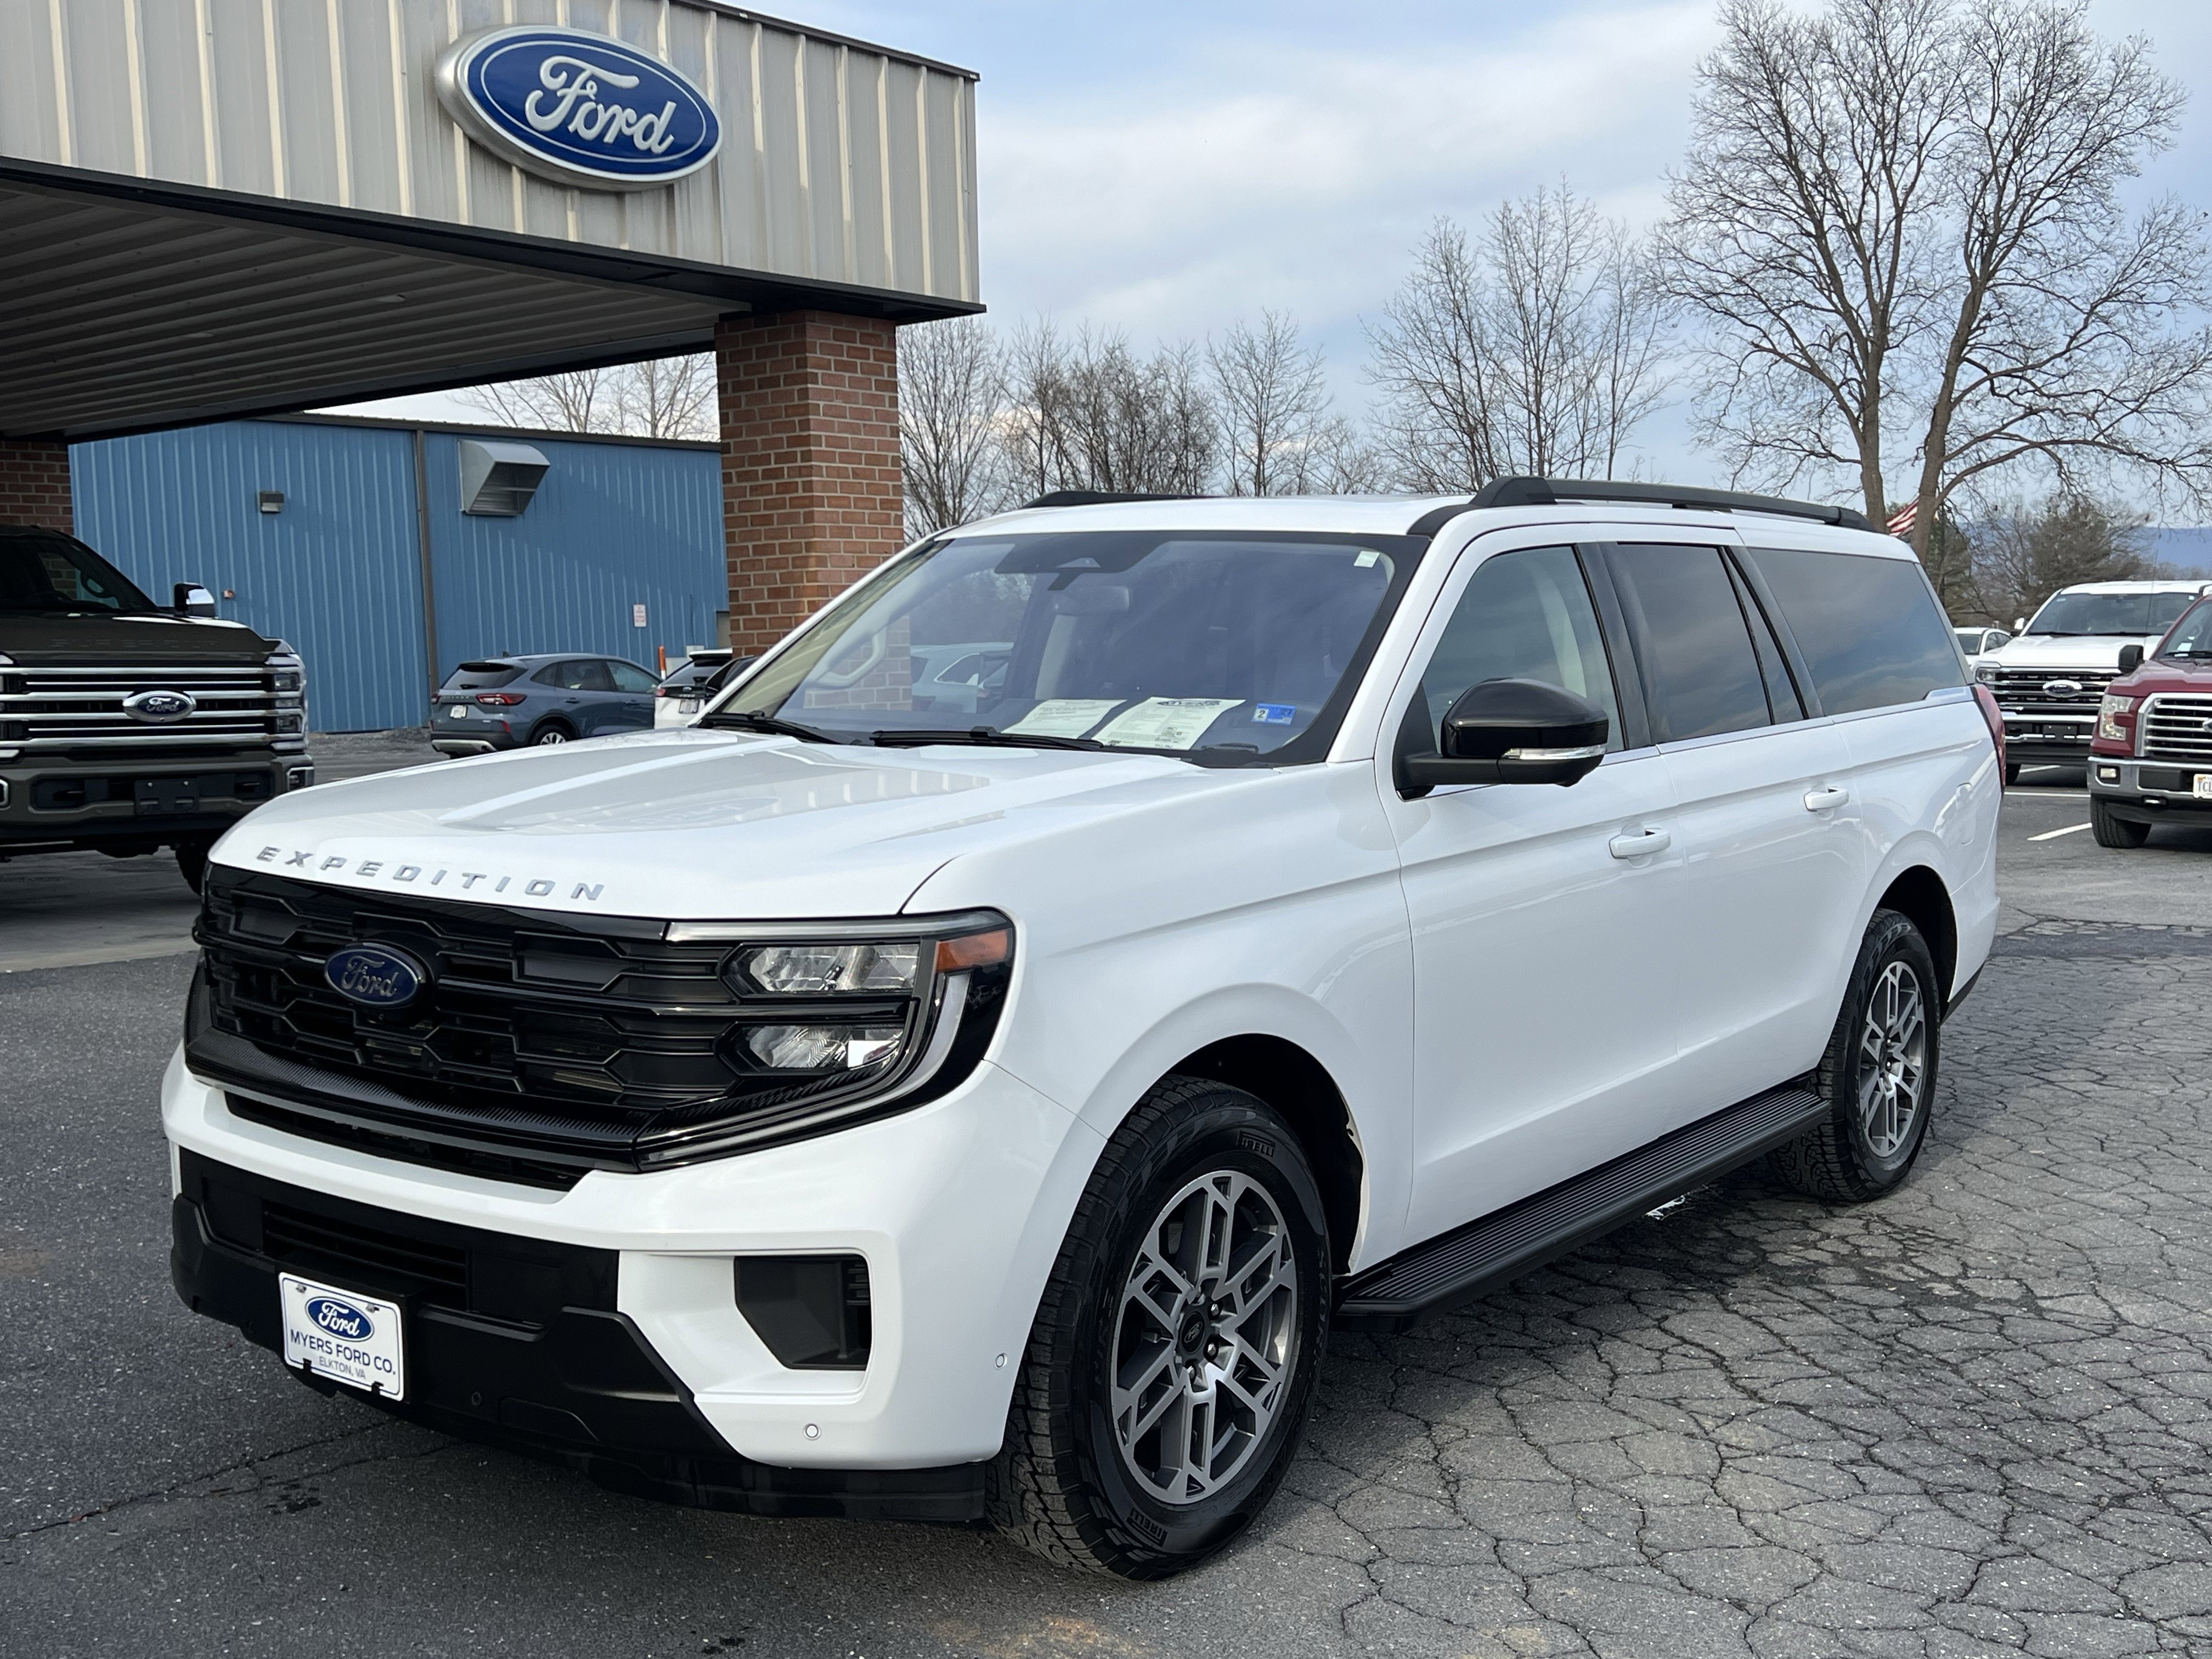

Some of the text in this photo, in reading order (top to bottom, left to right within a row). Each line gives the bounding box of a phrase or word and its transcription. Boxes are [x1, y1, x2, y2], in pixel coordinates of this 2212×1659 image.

[525, 55, 676, 154] Ford
[145, 697, 179, 712] Ford
[1257, 709, 1266, 719] 2
[256, 846, 605, 901] EXPEDITION
[341, 955, 399, 998] Ford
[318, 1301, 360, 1336] Ford
[290, 1329, 396, 1375] MYERS FORD CO.
[319, 1356, 366, 1380] ELKTON, VA
